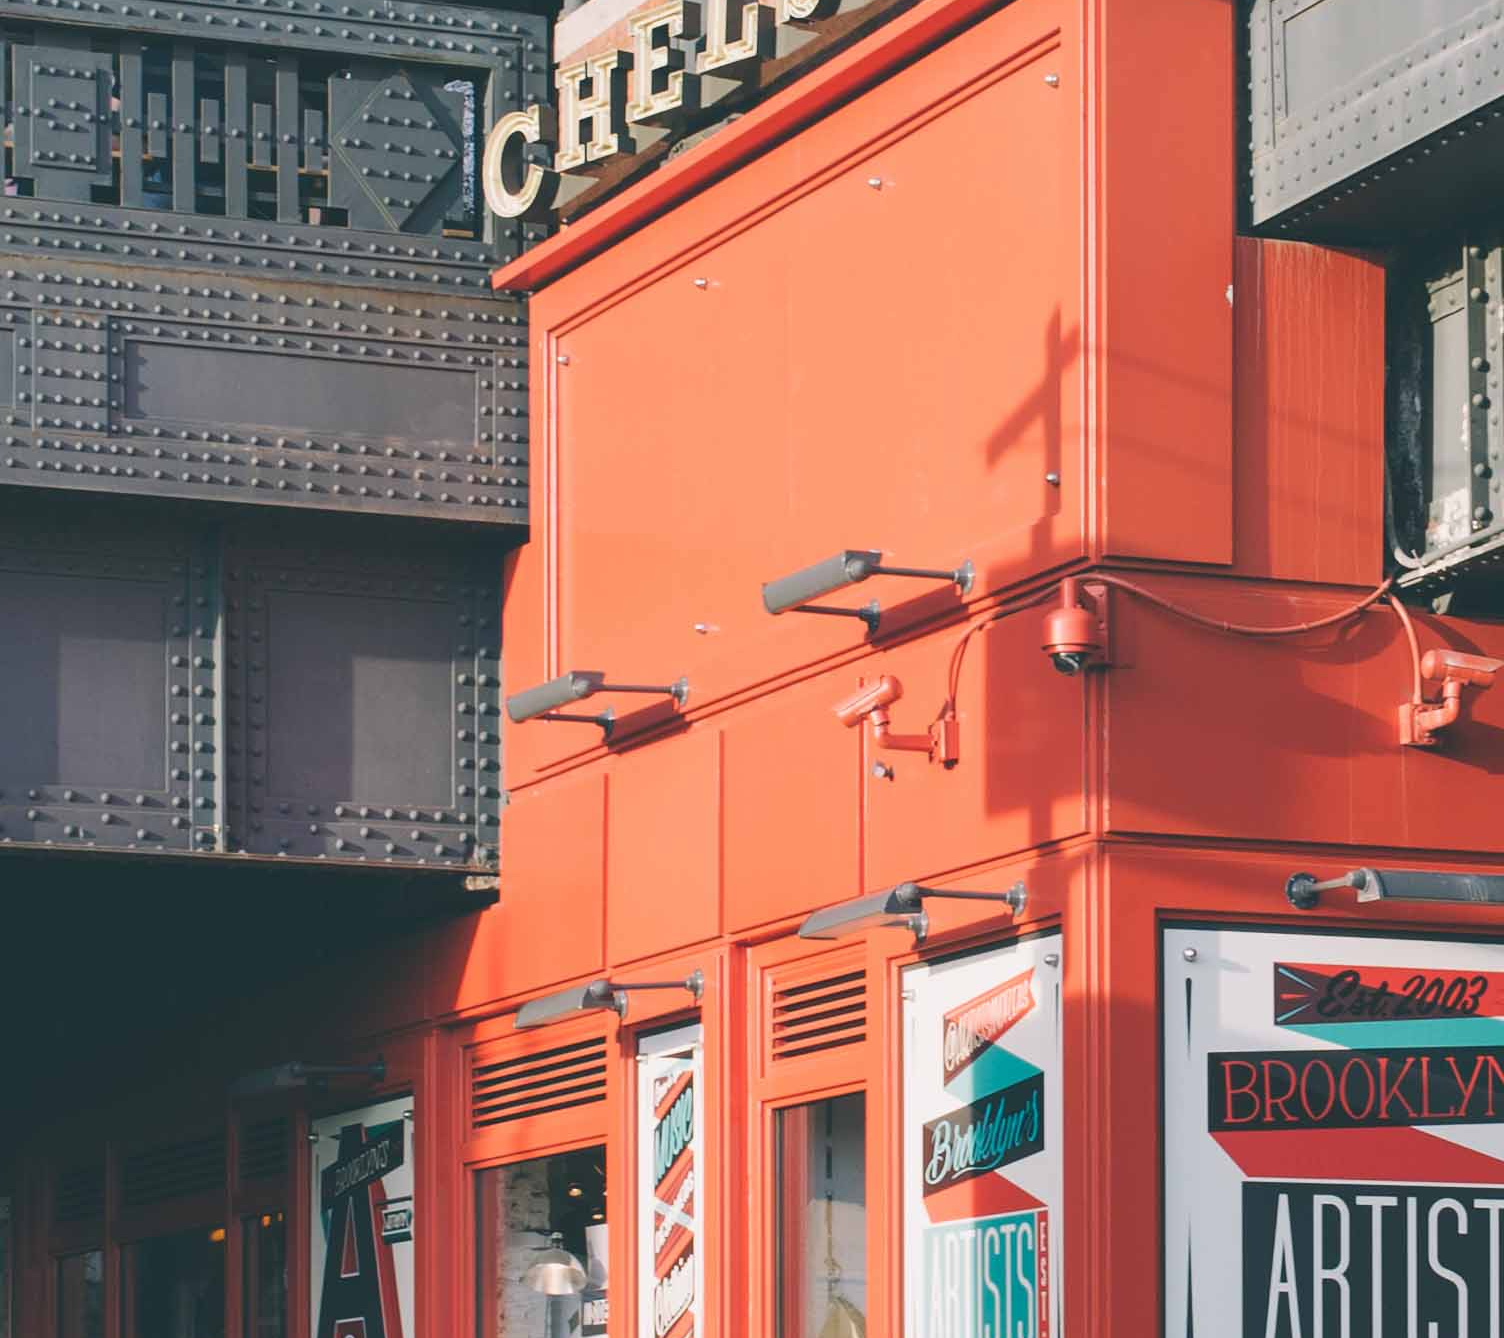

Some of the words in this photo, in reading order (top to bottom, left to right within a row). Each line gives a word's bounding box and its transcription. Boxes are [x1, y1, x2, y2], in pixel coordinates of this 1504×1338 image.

[1316, 969, 1388, 1019] Est.
[1392, 974, 1488, 1016] 2003
[924, 1088, 1039, 1185] Brooklyn's
